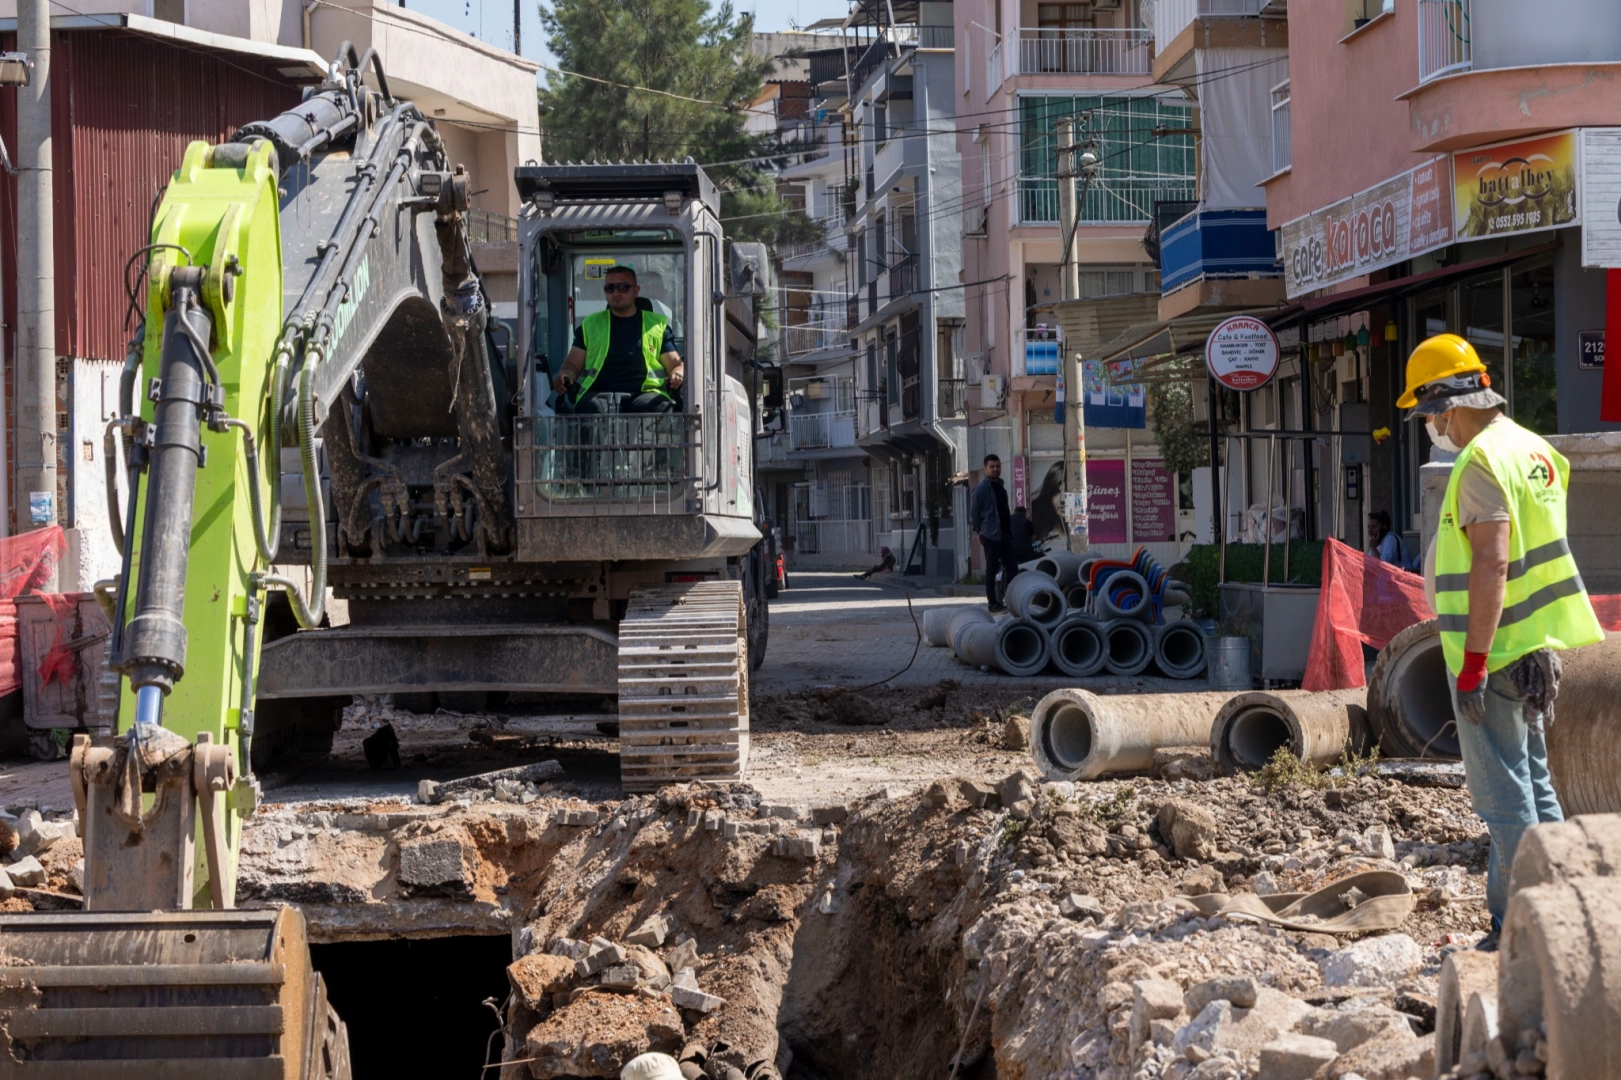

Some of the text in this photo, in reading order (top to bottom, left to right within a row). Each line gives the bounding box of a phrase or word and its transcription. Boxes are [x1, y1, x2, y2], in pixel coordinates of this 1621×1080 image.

[1479, 167, 1554, 195] battalbey
[1495, 211, 1541, 229] 0552 595 1935
[1292, 200, 1396, 284] cafe karaca
[1226, 322, 1260, 332] KARACA
[1584, 341, 1605, 353] 212
[1086, 484, 1121, 499] Güneş
[1091, 503, 1116, 512] bayan
